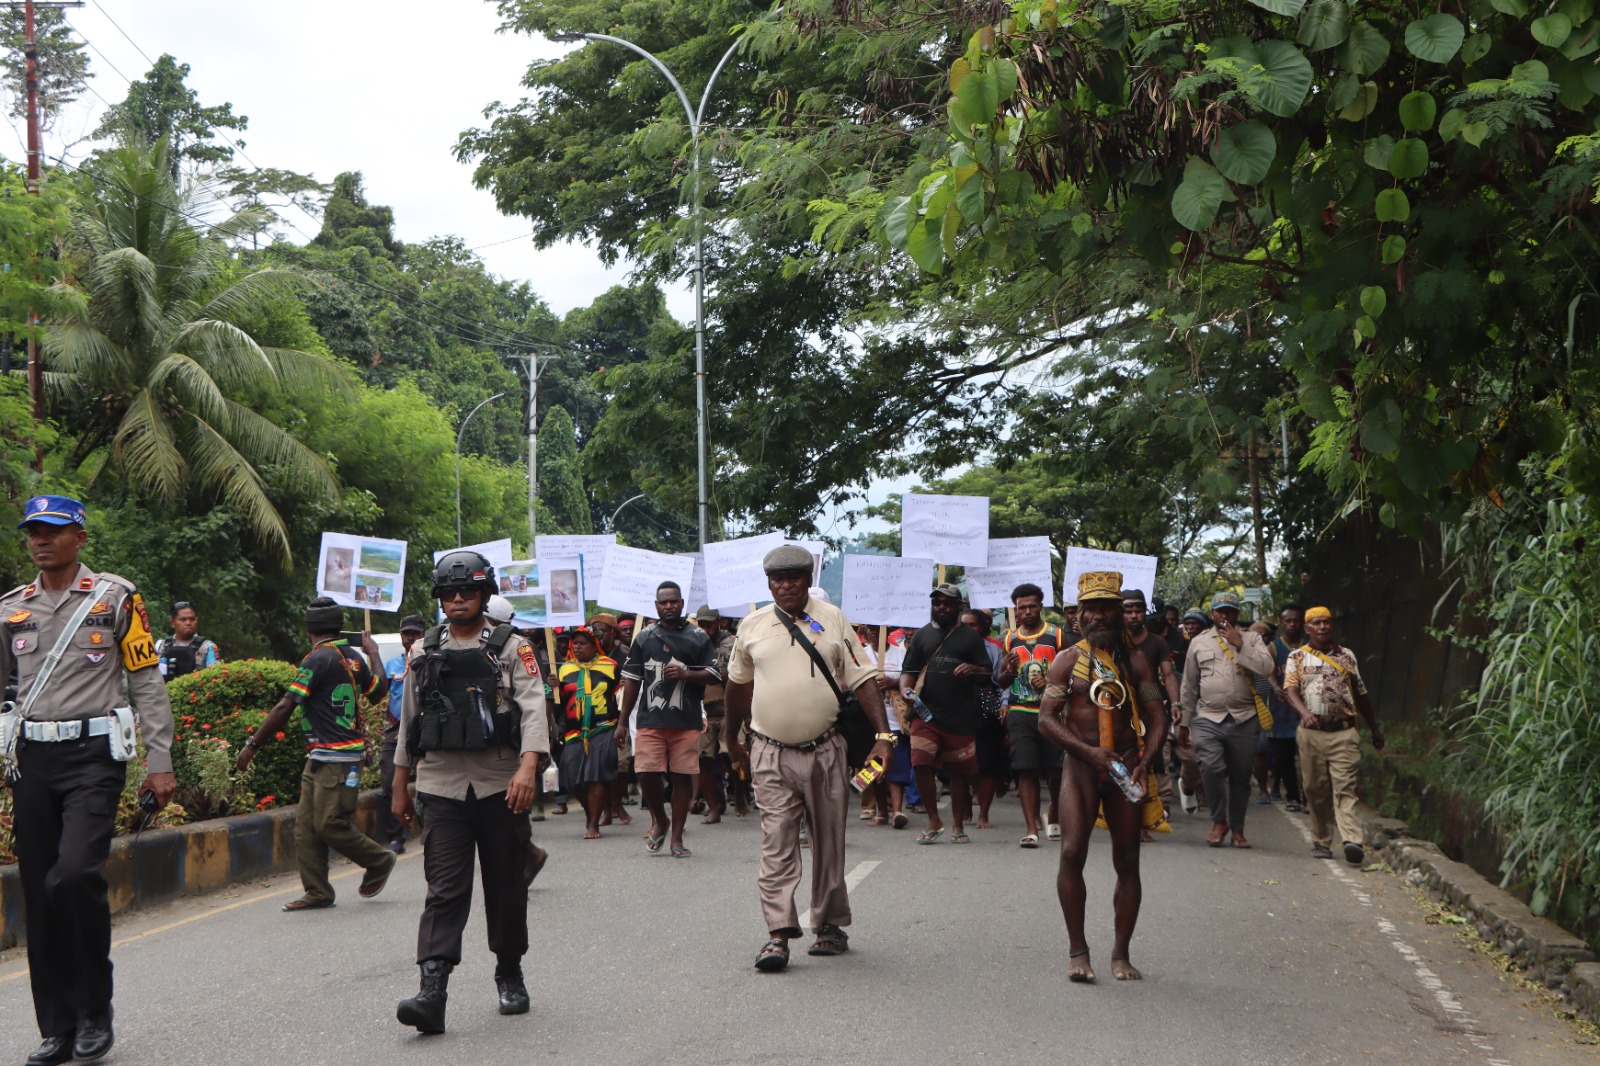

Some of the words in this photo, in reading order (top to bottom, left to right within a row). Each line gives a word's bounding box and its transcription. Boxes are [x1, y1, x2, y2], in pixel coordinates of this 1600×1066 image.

[83, 616, 114, 627] OLRI
[561, 681, 608, 719] 24
[644, 656, 688, 712] 27
